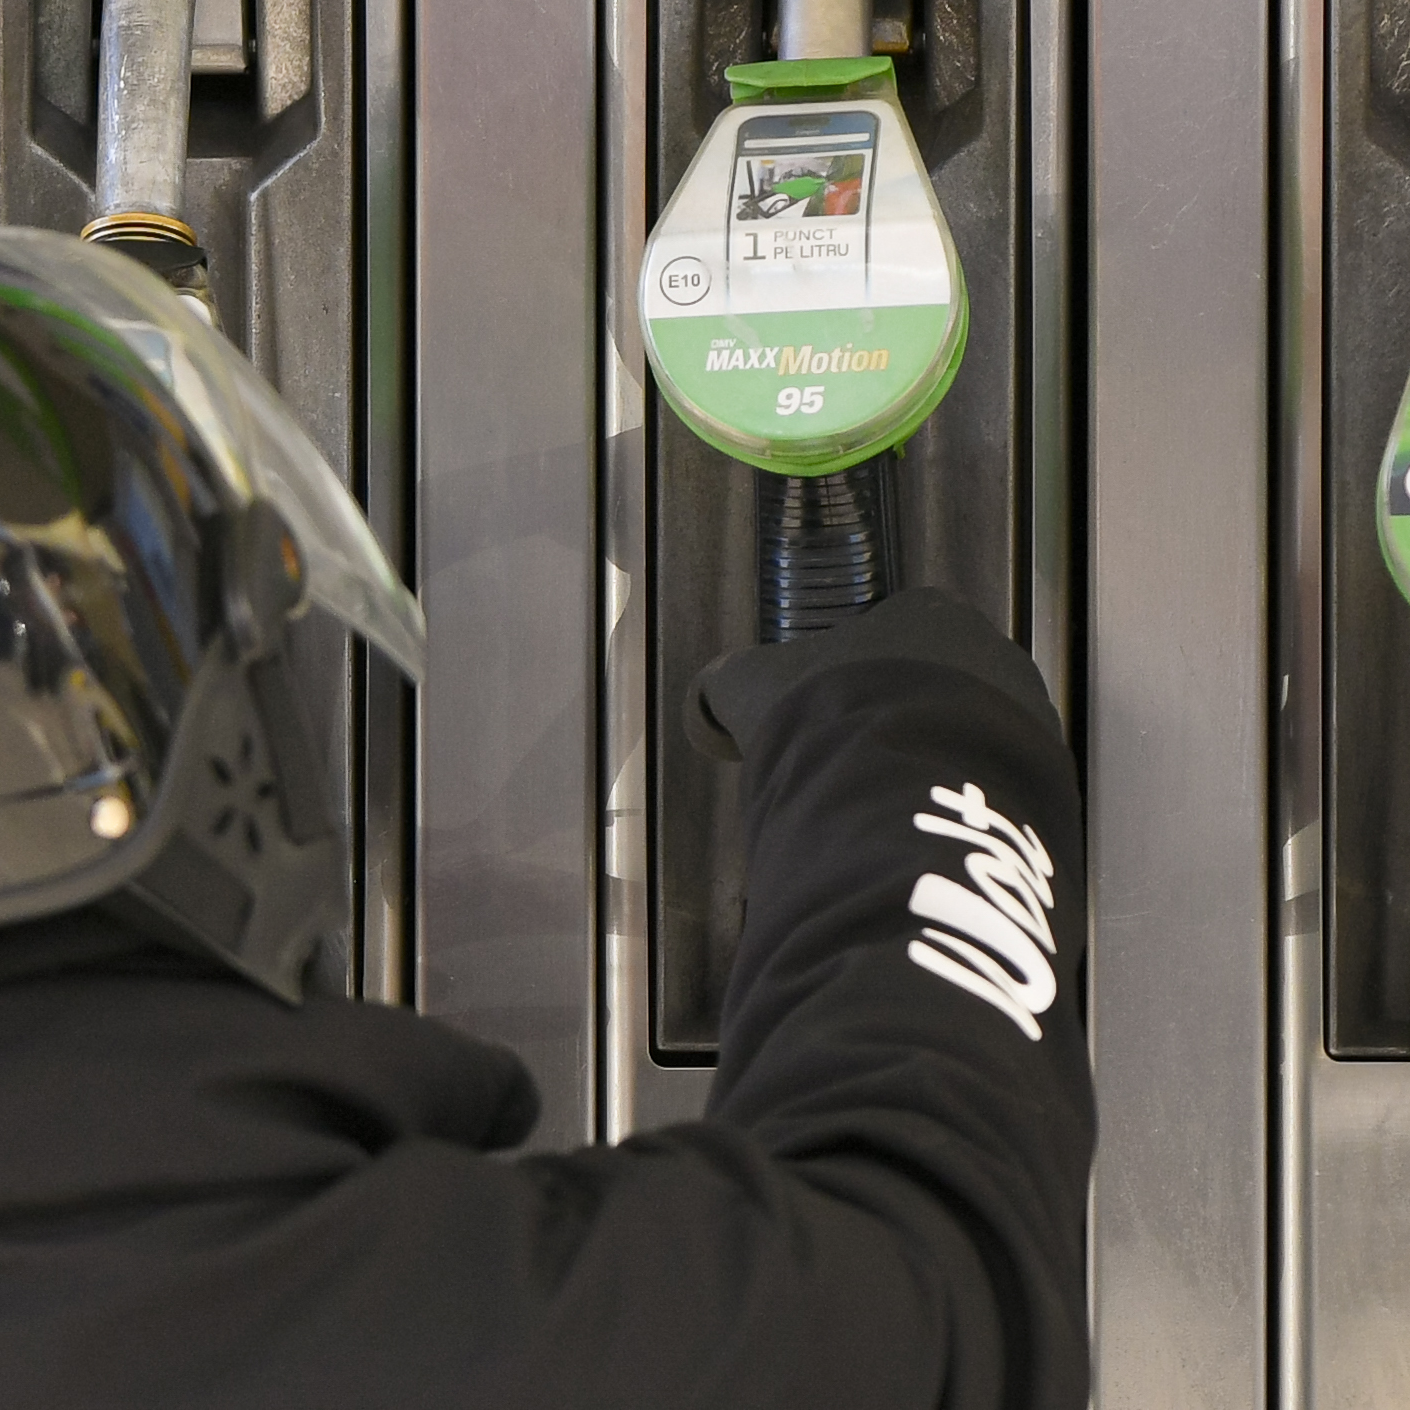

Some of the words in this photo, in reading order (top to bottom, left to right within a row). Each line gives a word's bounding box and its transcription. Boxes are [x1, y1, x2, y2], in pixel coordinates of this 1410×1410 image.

[773, 228, 837, 243] PUNCT
[742, 233, 767, 262] 1
[773, 246, 792, 260] PE
[799, 243, 849, 259] LITRU
[667, 273, 701, 289] E10
[775, 386, 825, 416] 95
[907, 782, 1057, 1042] Wolt
